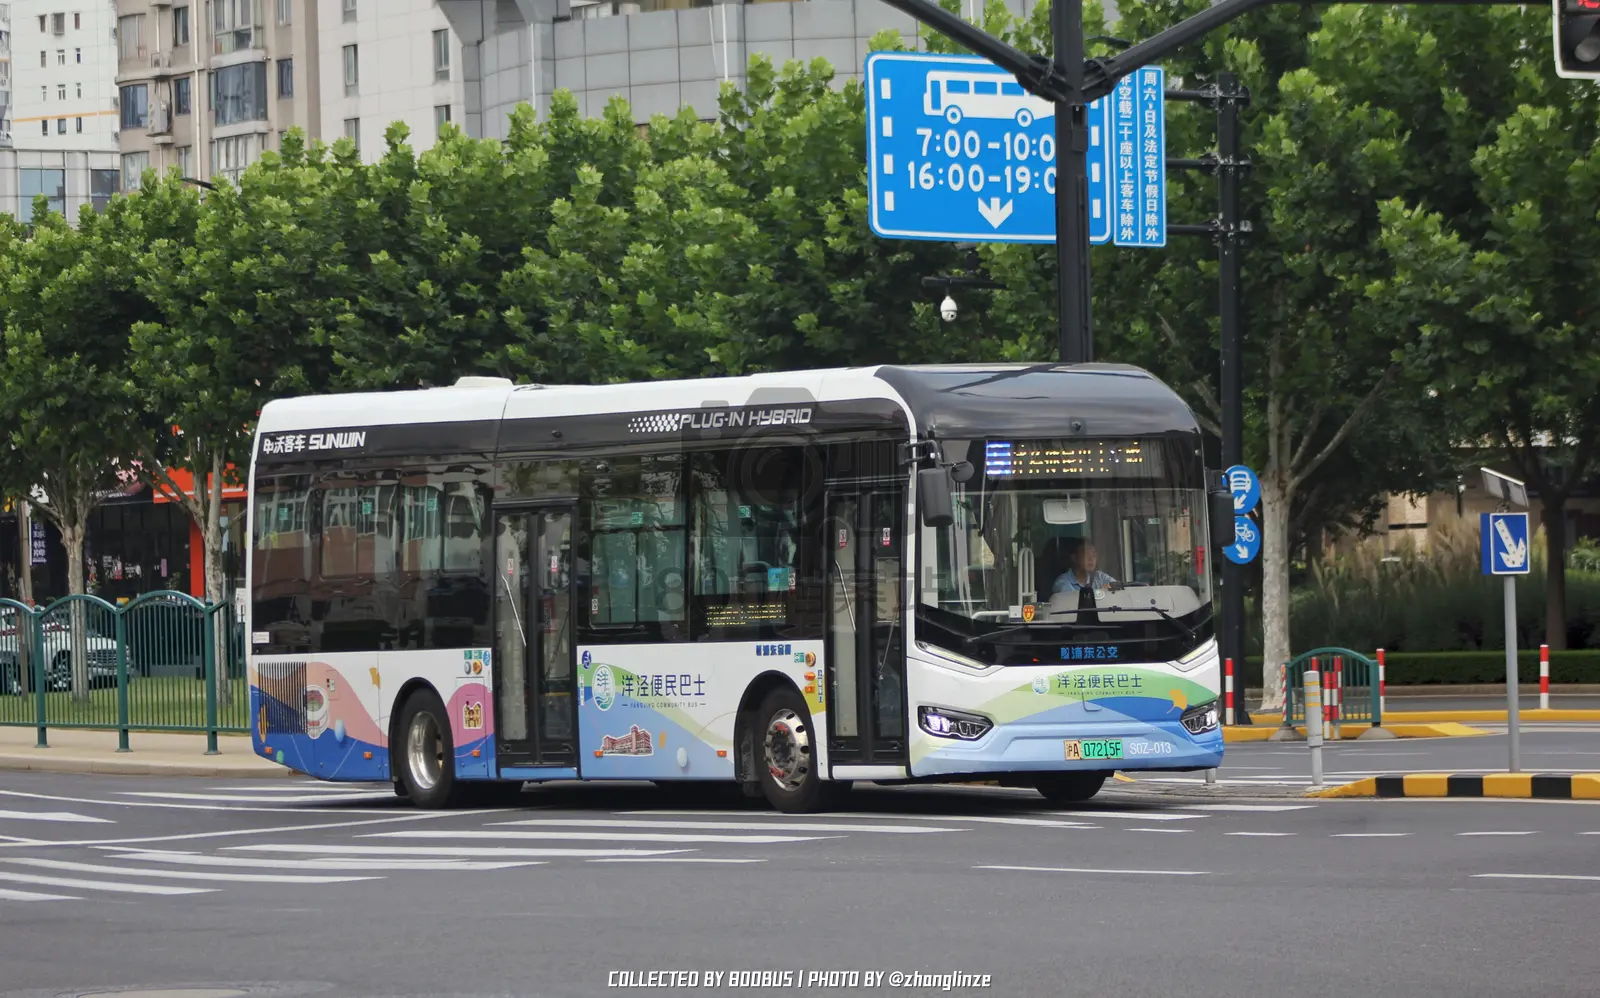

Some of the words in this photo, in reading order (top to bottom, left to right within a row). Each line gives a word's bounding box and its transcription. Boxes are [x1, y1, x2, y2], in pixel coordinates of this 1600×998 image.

[916, 128, 1056, 162] 7:00-10:0
[908, 161, 1057, 194] 16:00-19:0
[748, 408, 812, 426] HYBRID
[309, 431, 366, 450] SUNWIN
[1071, 646, 1118, 660] 浦东公交
[621, 674, 706, 697] 洋泾便民巴士
[1057, 674, 1142, 688] 洋泾便民巴士
